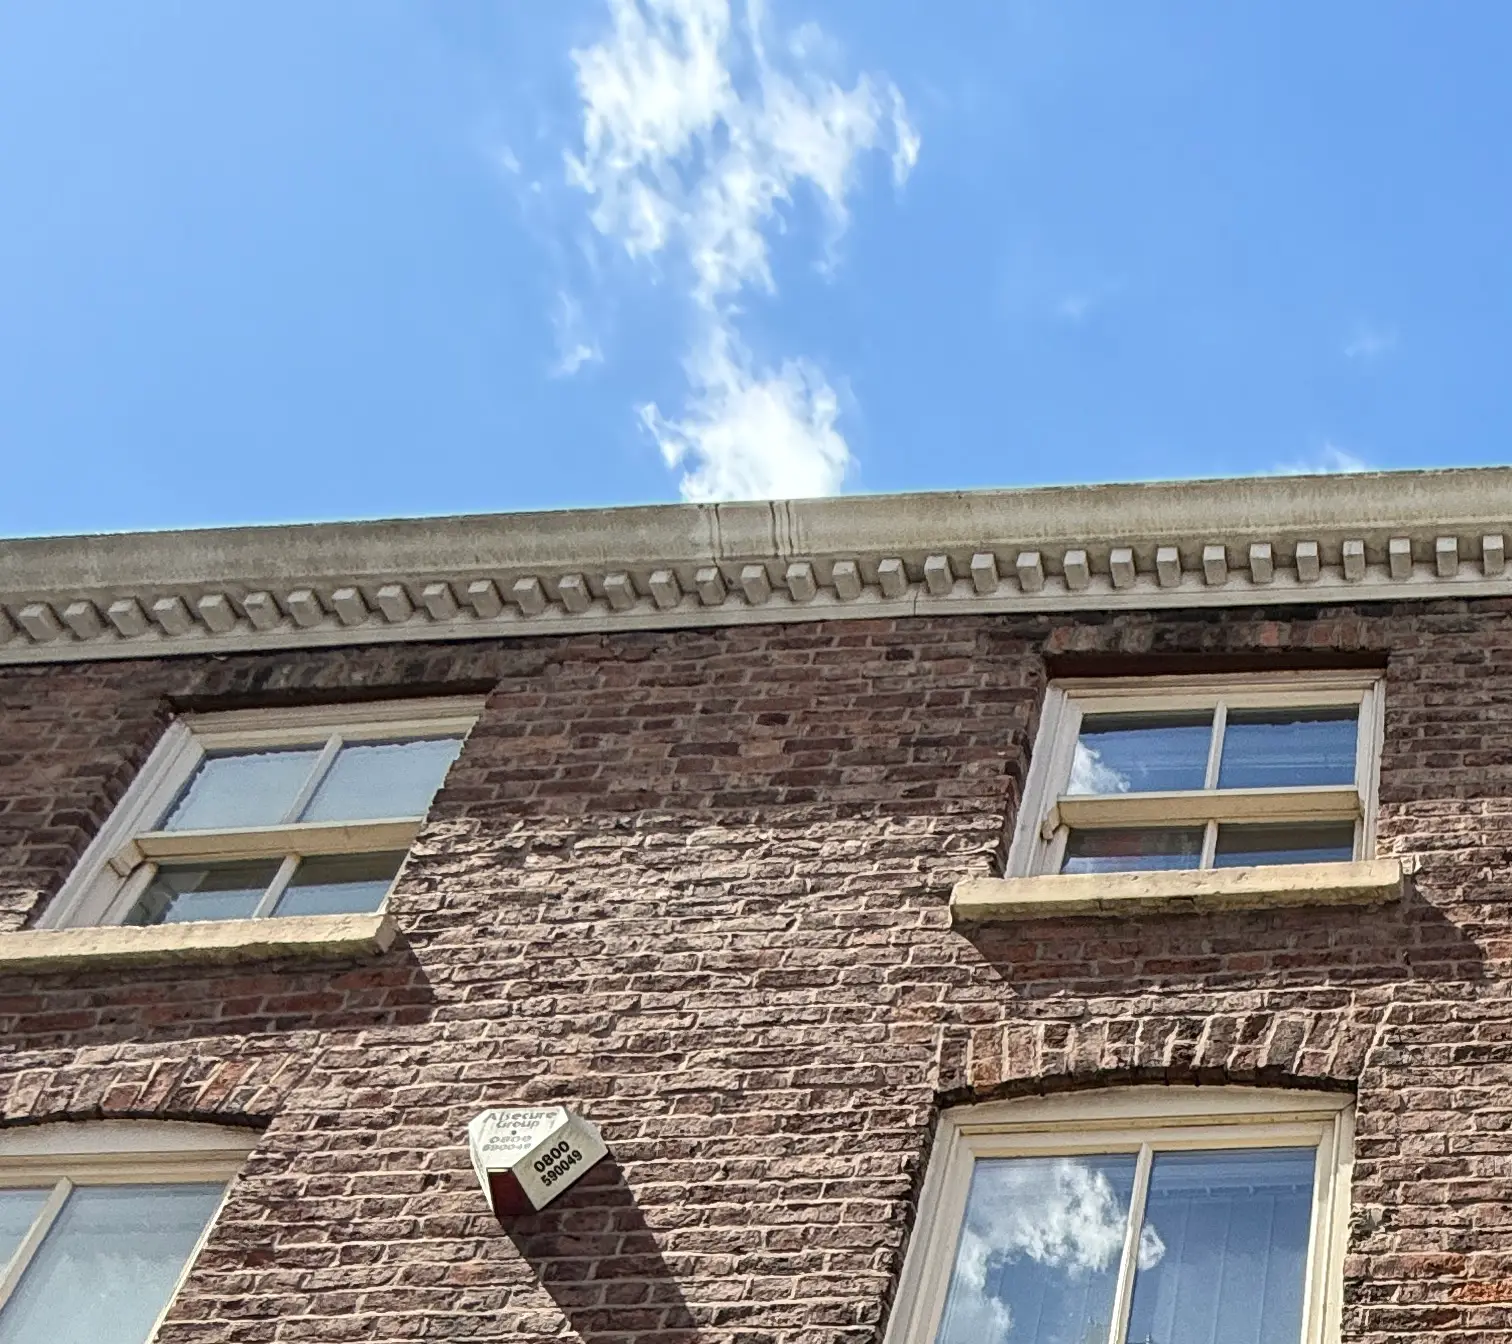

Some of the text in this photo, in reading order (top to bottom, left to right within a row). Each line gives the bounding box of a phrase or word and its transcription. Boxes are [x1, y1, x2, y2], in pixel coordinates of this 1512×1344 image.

[496, 1120, 540, 1129] Group
[533, 1140, 570, 1173] 0800
[540, 1149, 583, 1187] 590049
